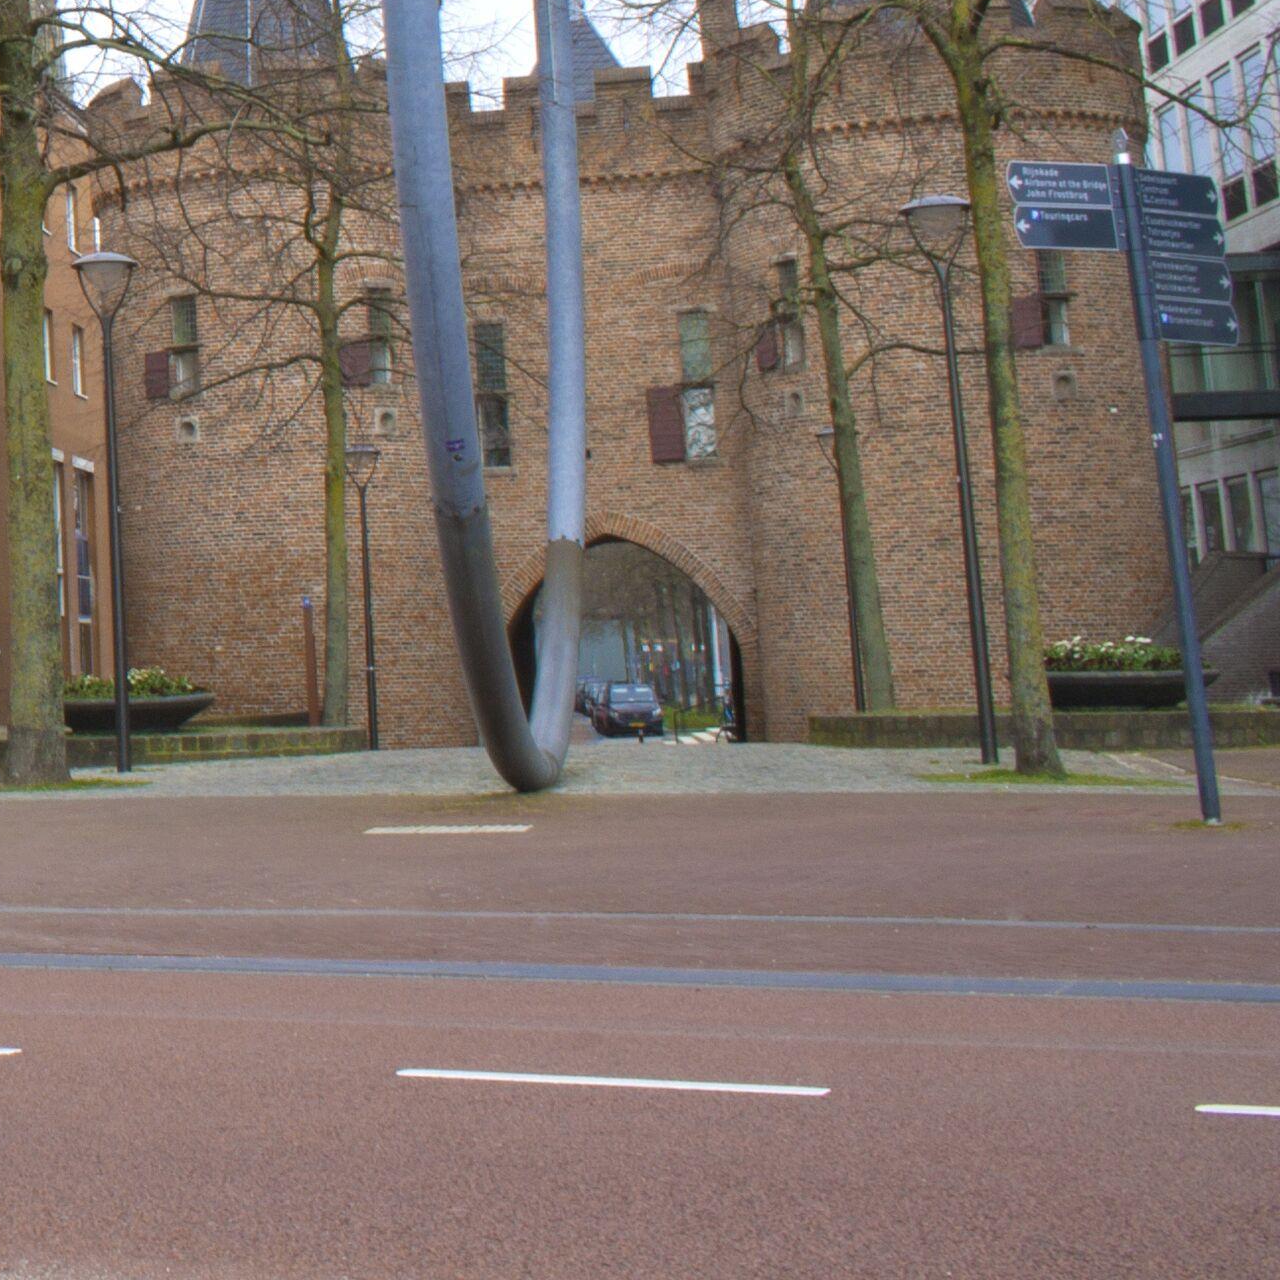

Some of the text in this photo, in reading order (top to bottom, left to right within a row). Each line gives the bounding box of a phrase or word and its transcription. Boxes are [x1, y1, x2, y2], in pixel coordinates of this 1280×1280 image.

[1024, 178, 1107, 192] Airborne at the Bridge
[1026, 189, 1088, 201] John Frostbrug
[1040, 210, 1088, 223] Touringcars
